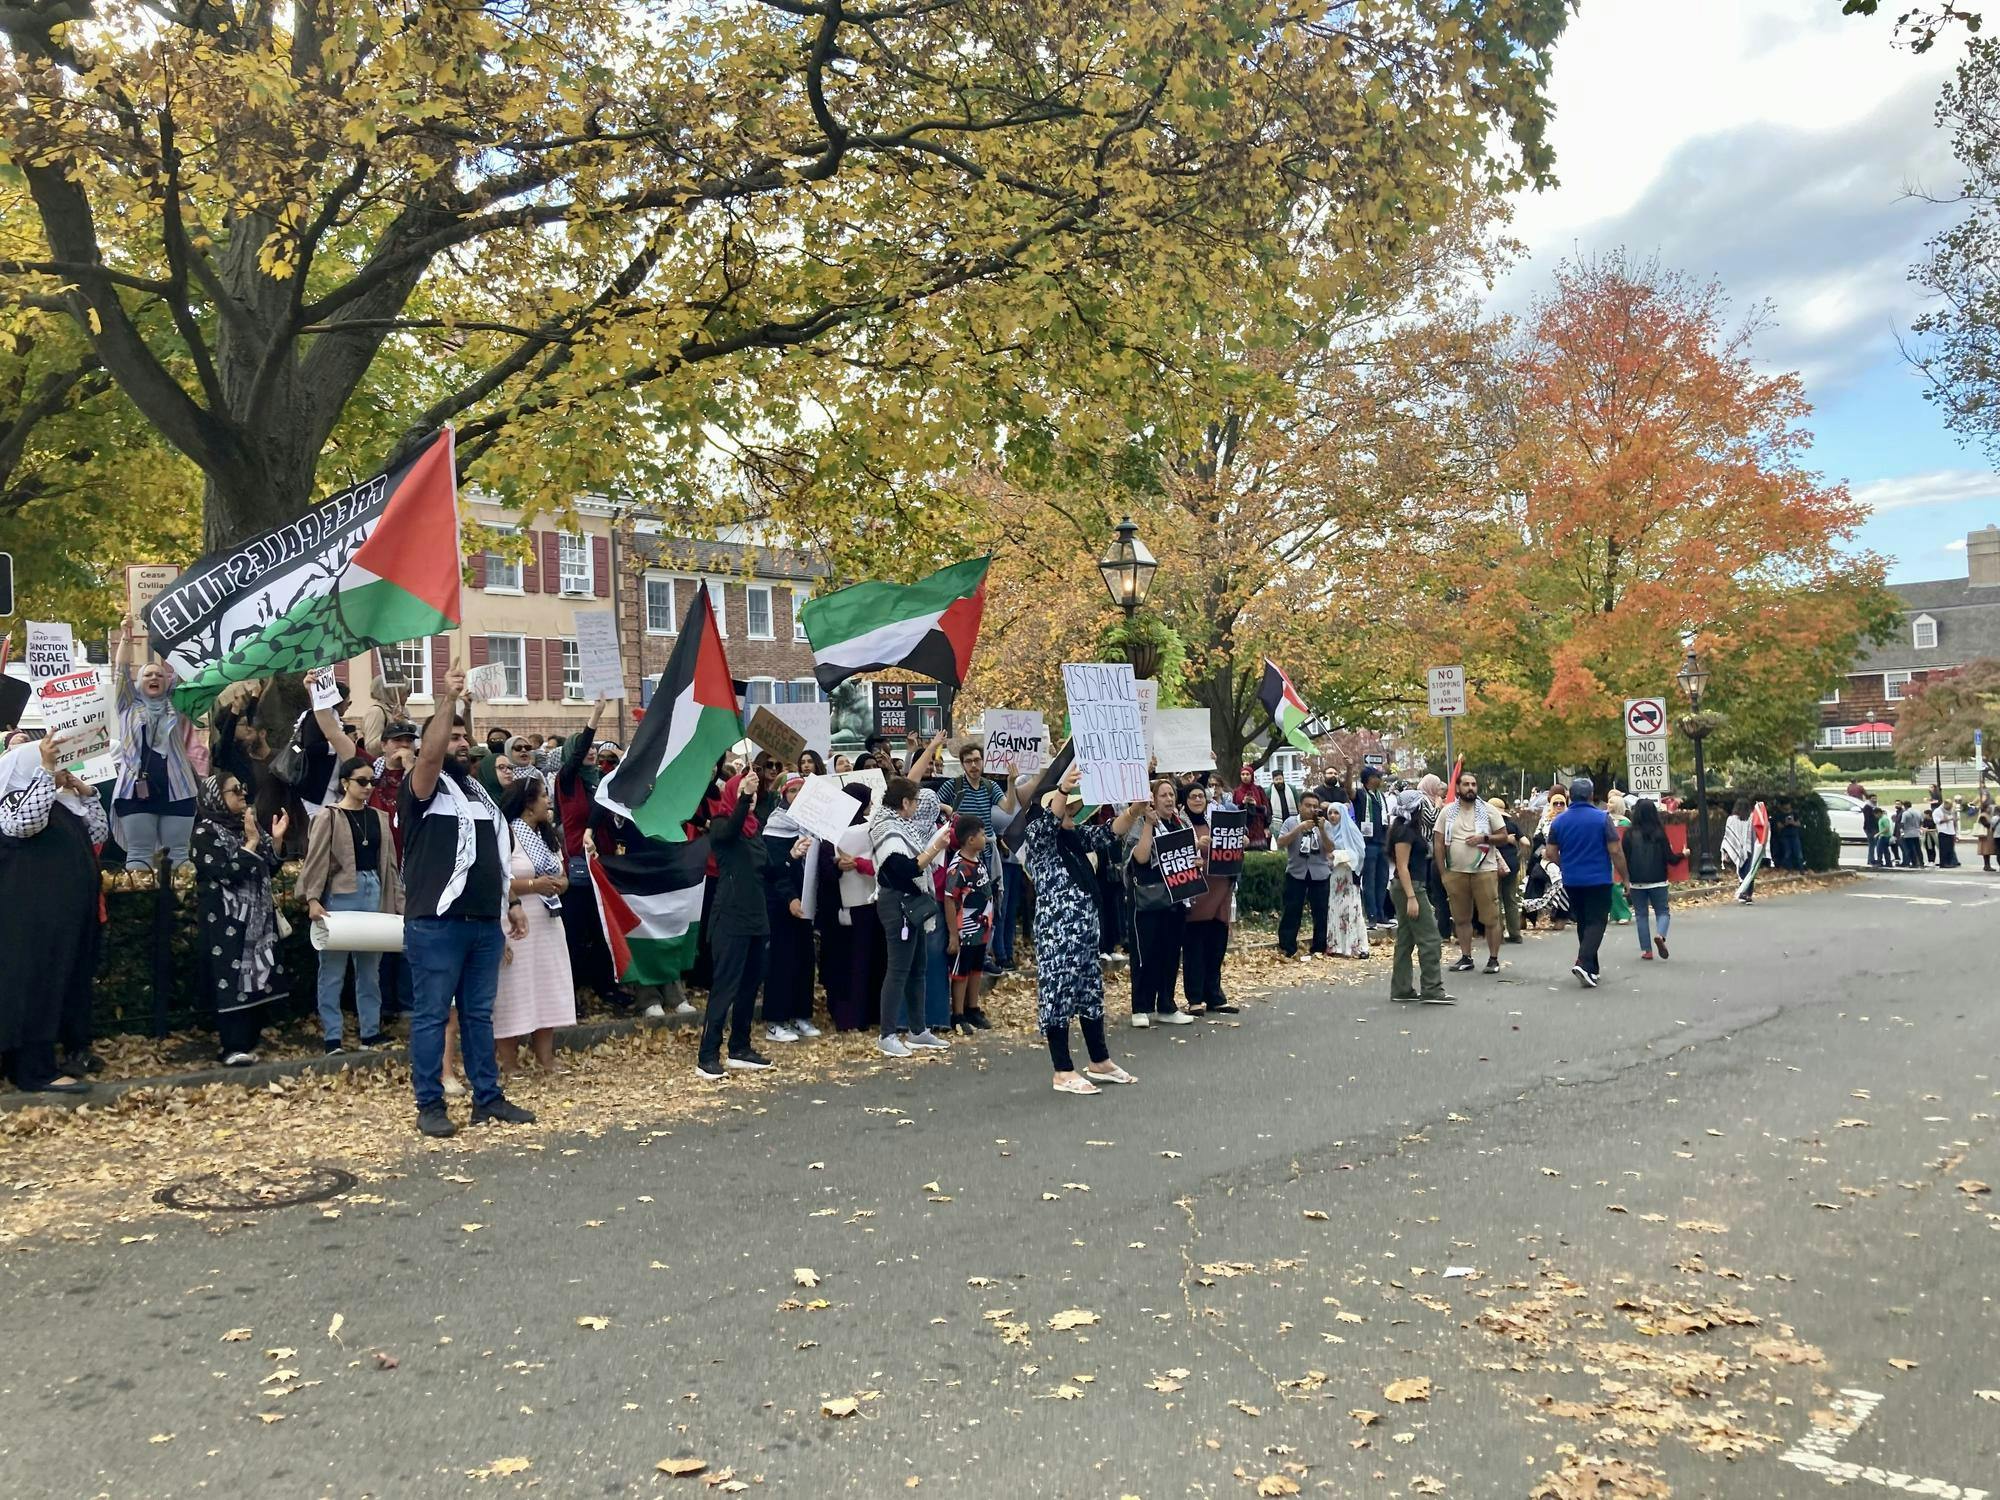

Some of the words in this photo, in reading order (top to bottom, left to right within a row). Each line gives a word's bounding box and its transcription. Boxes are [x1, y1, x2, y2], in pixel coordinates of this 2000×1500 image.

[30, 652, 70, 662] ISRAEL
[30, 664, 70, 676] NOW!
[1438, 670, 1453, 680] NO
[37, 682, 70, 697] CEASE
[72, 672, 100, 688] FIRE!
[1062, 664, 1136, 702] RESISTANCE
[878, 686, 902, 694] STOP
[882, 718, 906, 726] FIRE
[1080, 704, 1140, 731] JUSTIFIED
[1001, 714, 1032, 734] JEWS
[986, 730, 1042, 752] AGAINST
[1073, 732, 1107, 760] WHEN
[1108, 731, 1145, 760] PEOPLE
[1639, 741, 1656, 752] NO
[1630, 752, 1664, 763] TRUCKS
[1634, 766, 1662, 777] CARS
[1635, 779, 1662, 790] ONLY
[1213, 826, 1244, 836] CEASE
[1212, 837, 1243, 849] FIRE
[1160, 845, 1194, 862] CEASE
[1162, 855, 1196, 875] FIRE
